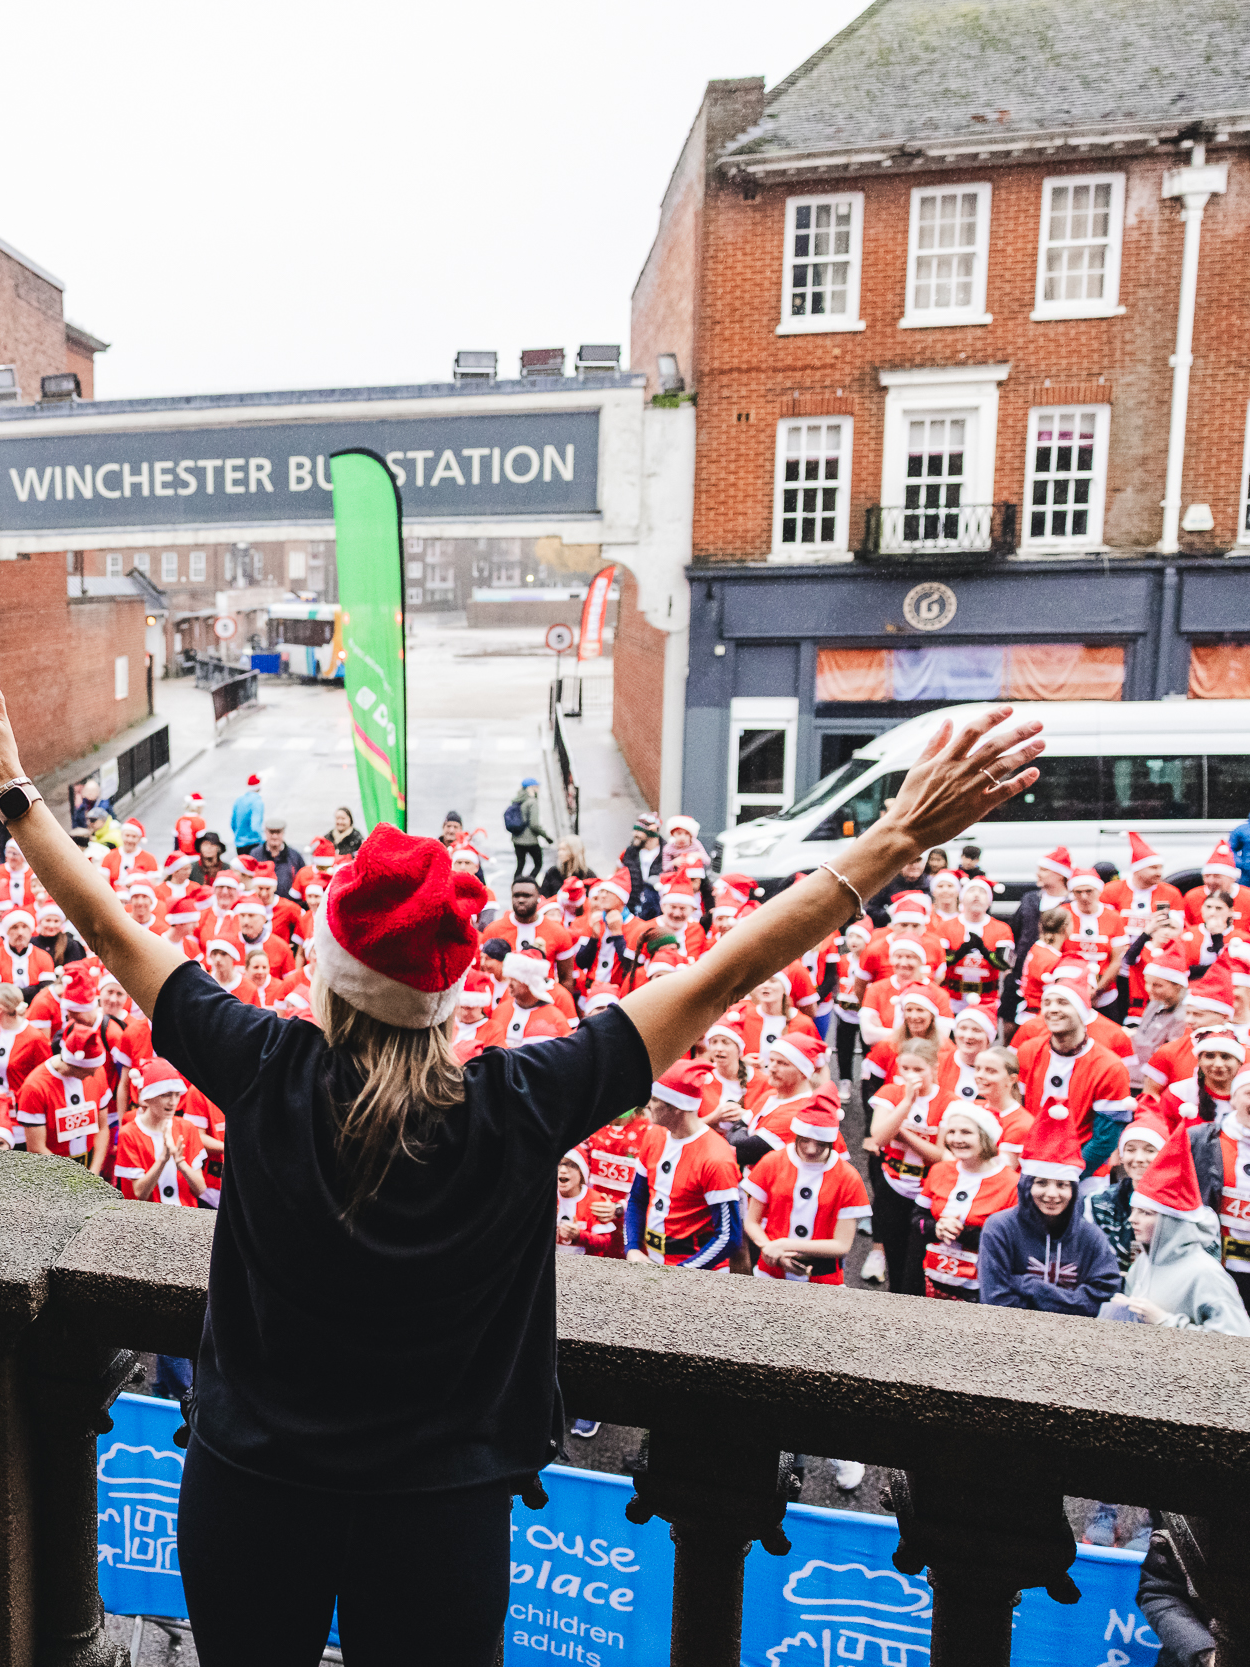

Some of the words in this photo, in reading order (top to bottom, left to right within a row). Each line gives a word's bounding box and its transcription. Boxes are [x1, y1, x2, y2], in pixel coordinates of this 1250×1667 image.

[9, 457, 274, 502] WINCHESTER
[288, 454, 335, 492] BU
[387, 443, 575, 488] STATION
[65, 1111, 90, 1131] 895
[598, 1160, 629, 1182] 563
[937, 1254, 959, 1276] 23
[510, 1604, 624, 1650] children
[512, 1630, 601, 1667] adults
